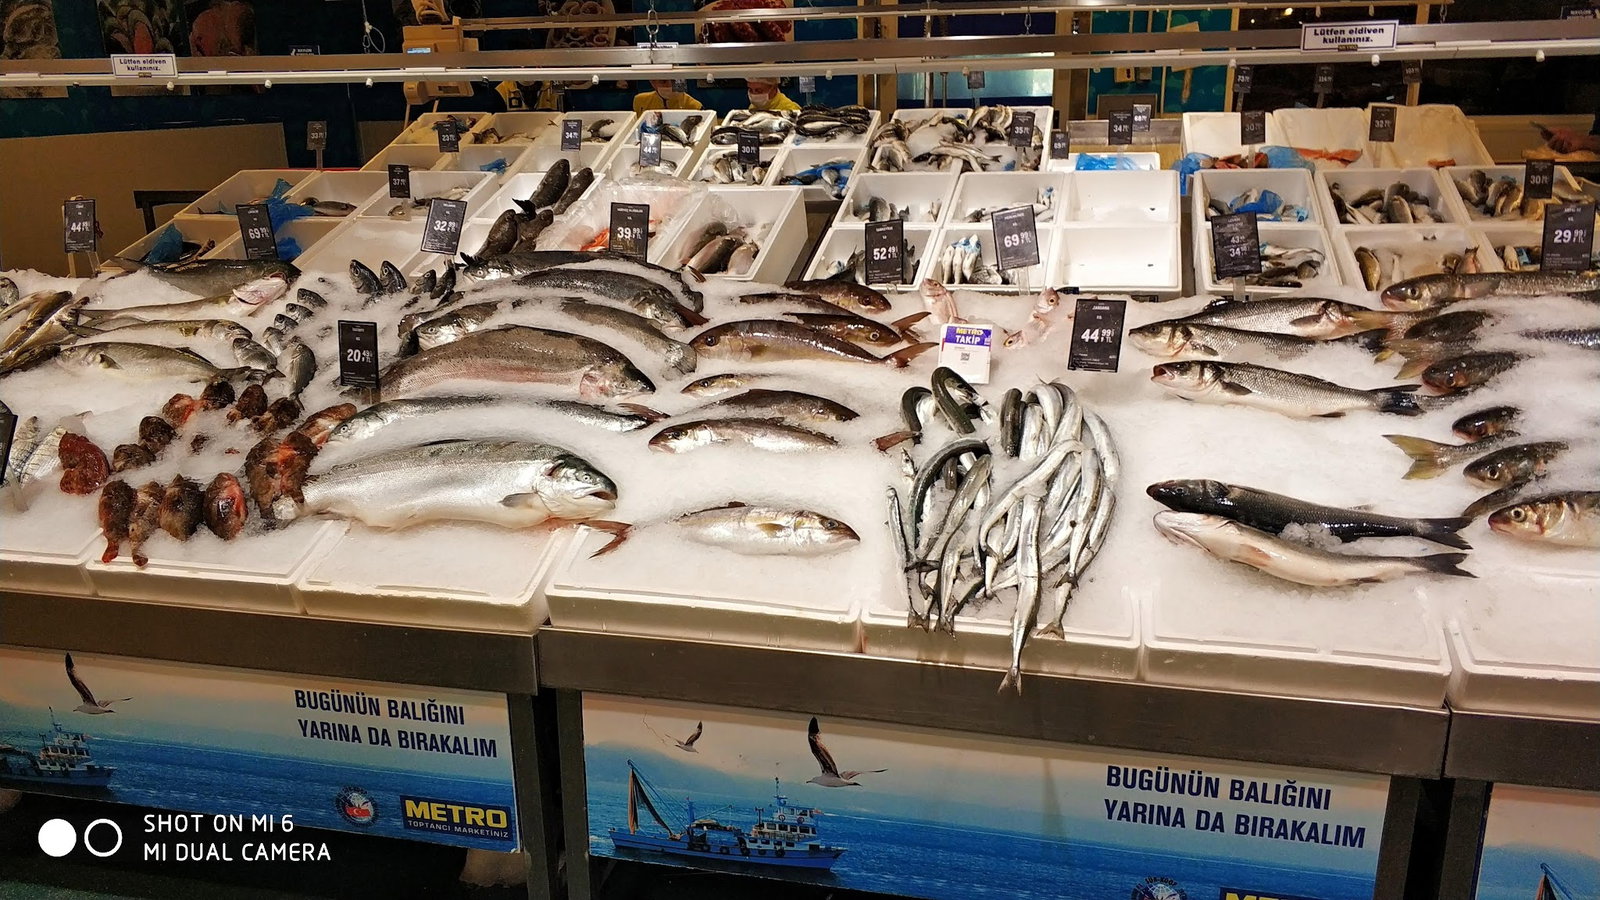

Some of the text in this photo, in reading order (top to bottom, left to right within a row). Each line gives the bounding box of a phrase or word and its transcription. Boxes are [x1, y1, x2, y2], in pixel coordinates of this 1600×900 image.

[1313, 27, 1385, 36] Lütfen eldiven
[955, 335, 981, 344] TAKİP
[294, 689, 465, 725] BUGÜNÜN BALIĞINI
[298, 718, 497, 758] YARINA DA BIRAKALIM
[1106, 765, 1332, 810] BUGÜNÜN BALIĞINI
[405, 799, 508, 829] METRO
[408, 820, 452, 831] TOPTANCI
[1104, 798, 1366, 848] YARINA DA BIRAKALIM
